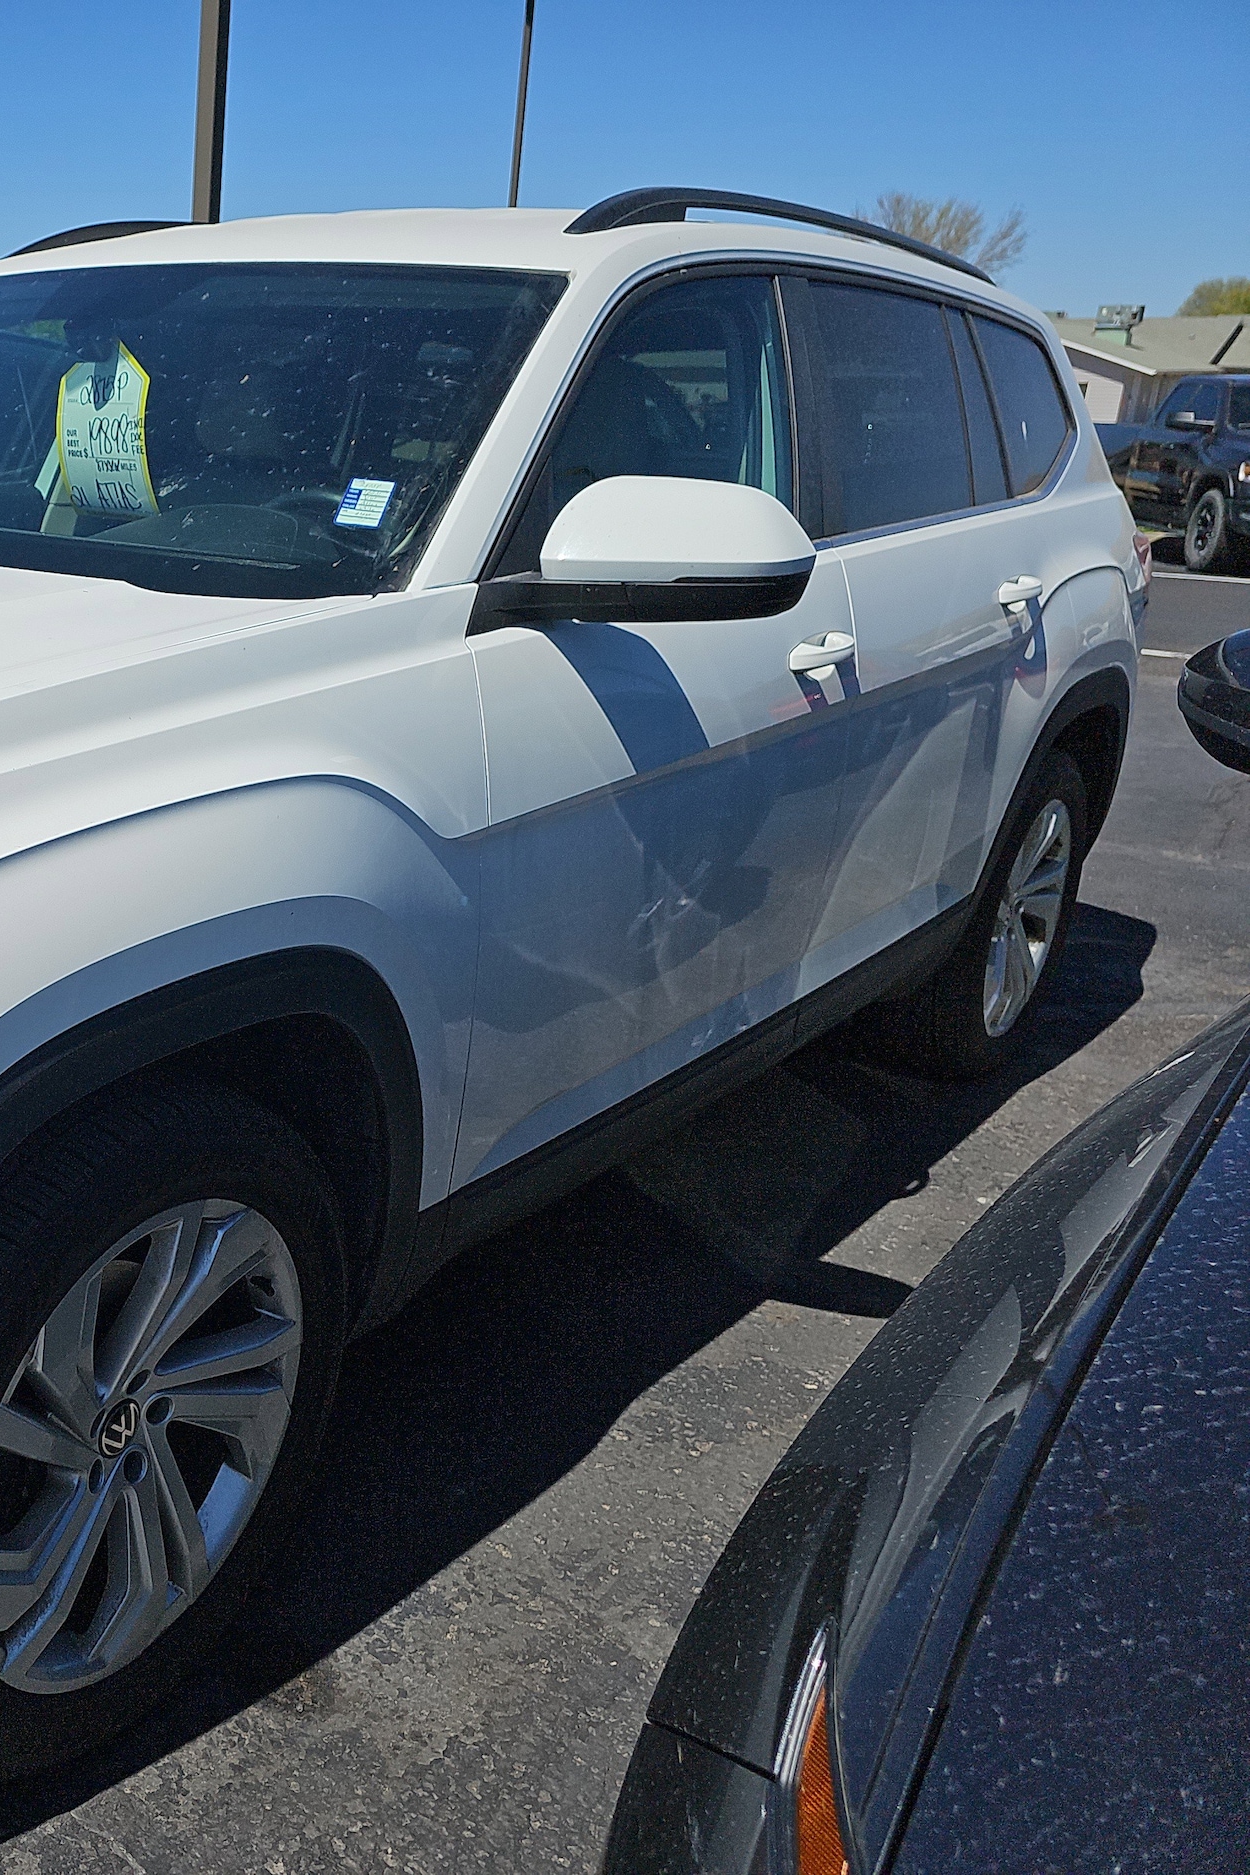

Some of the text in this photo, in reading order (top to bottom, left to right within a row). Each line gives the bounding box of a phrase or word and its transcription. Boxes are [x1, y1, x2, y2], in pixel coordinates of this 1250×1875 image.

[67, 429, 78, 437] OUR
[89, 413, 129, 458] 19898
[131, 445, 145, 456] FEE
